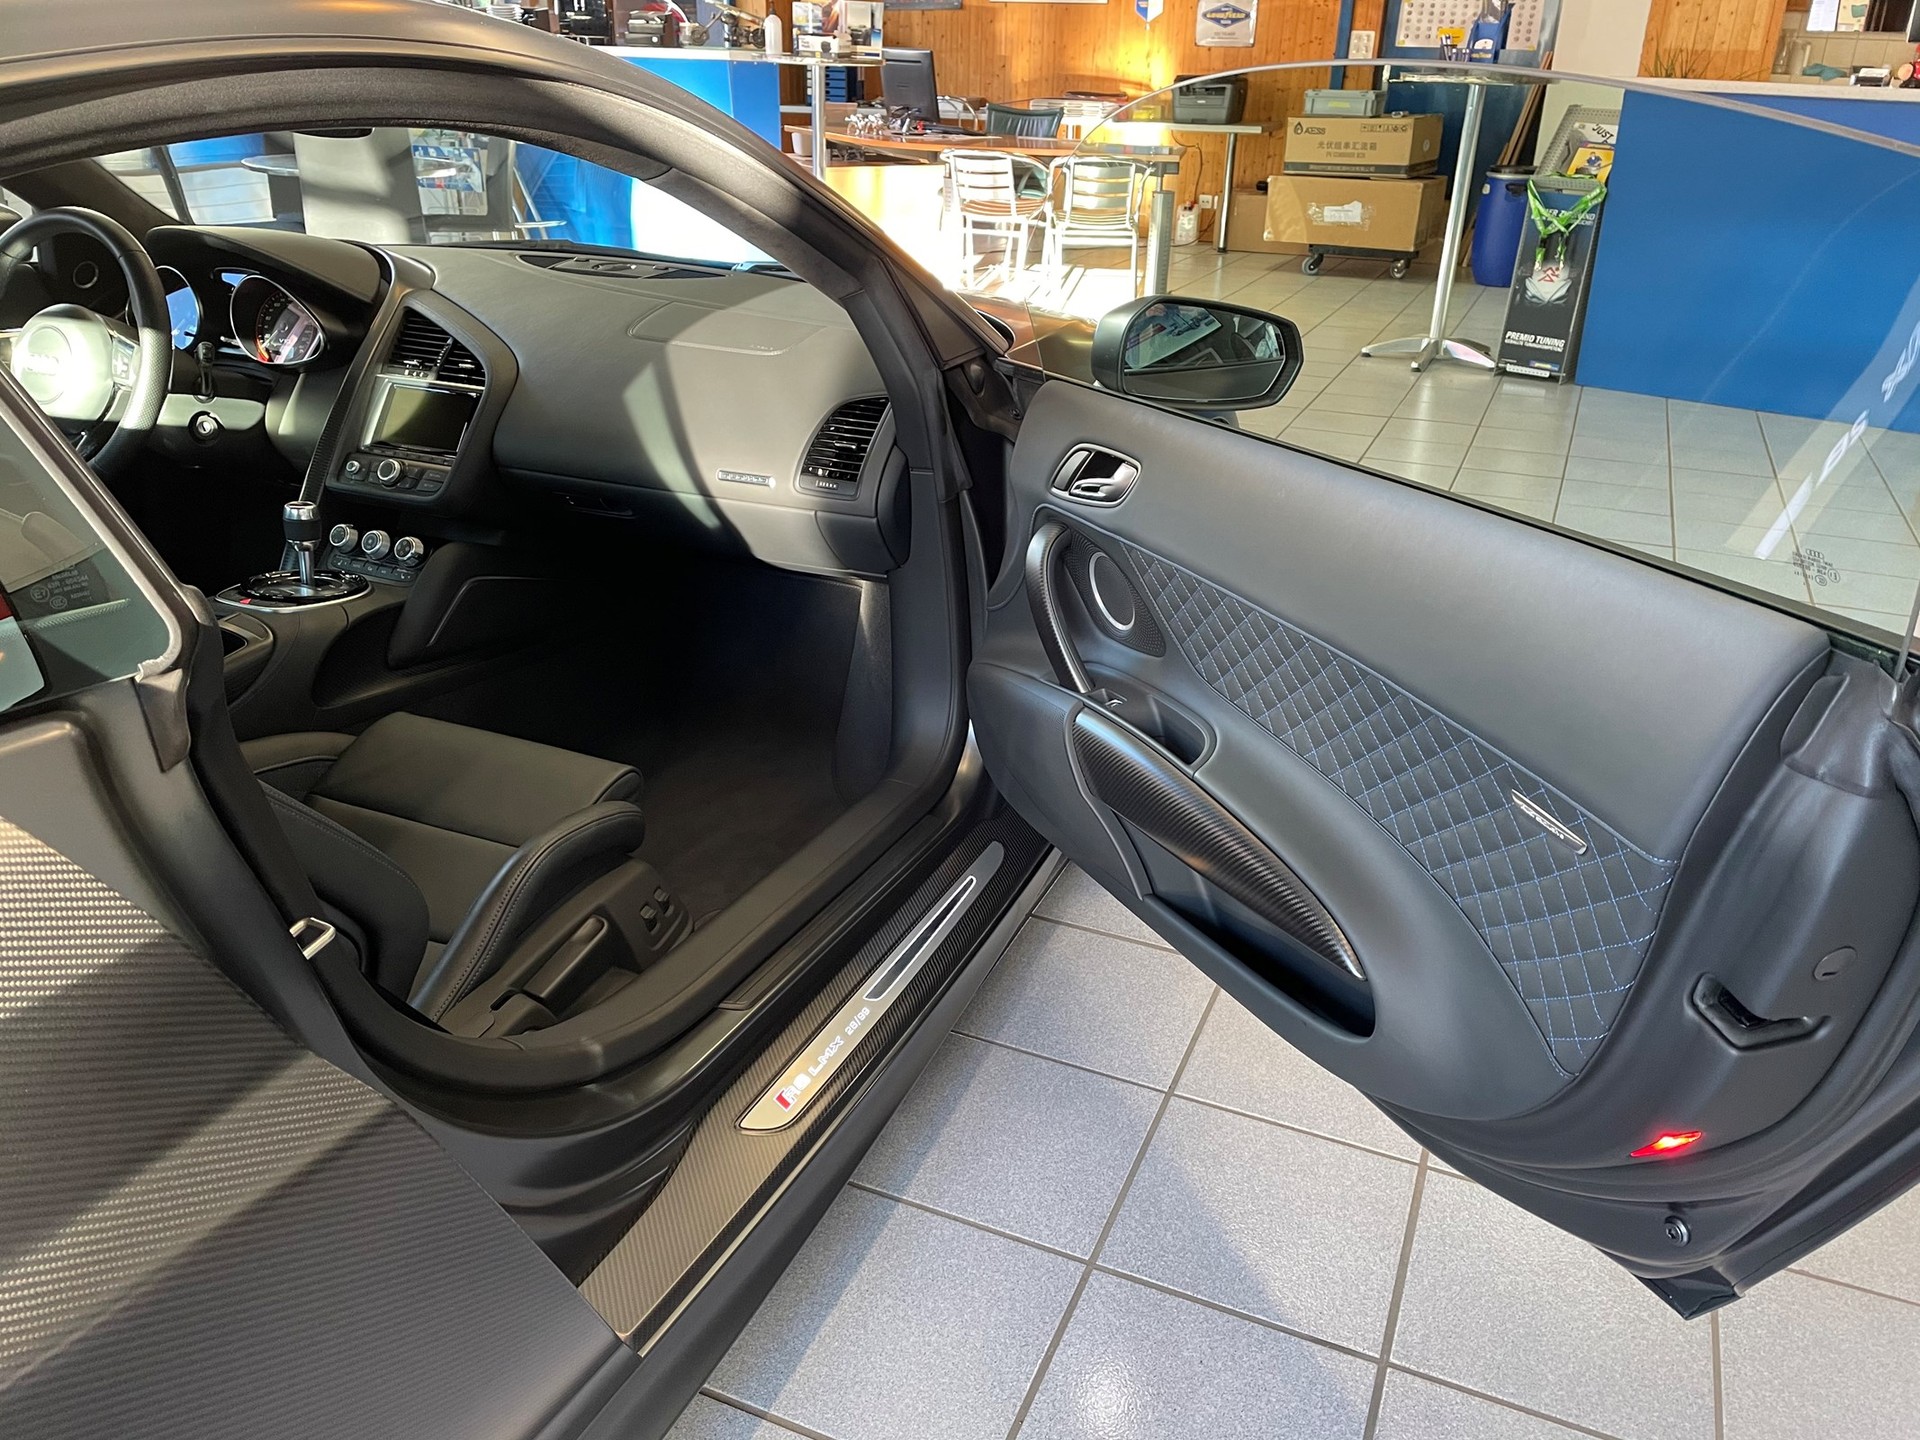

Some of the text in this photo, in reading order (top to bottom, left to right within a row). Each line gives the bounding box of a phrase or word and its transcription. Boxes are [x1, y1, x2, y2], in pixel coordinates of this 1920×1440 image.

[1505, 331, 1566, 348] PREMIO TUNING
[808, 1035, 845, 1078] LMX
